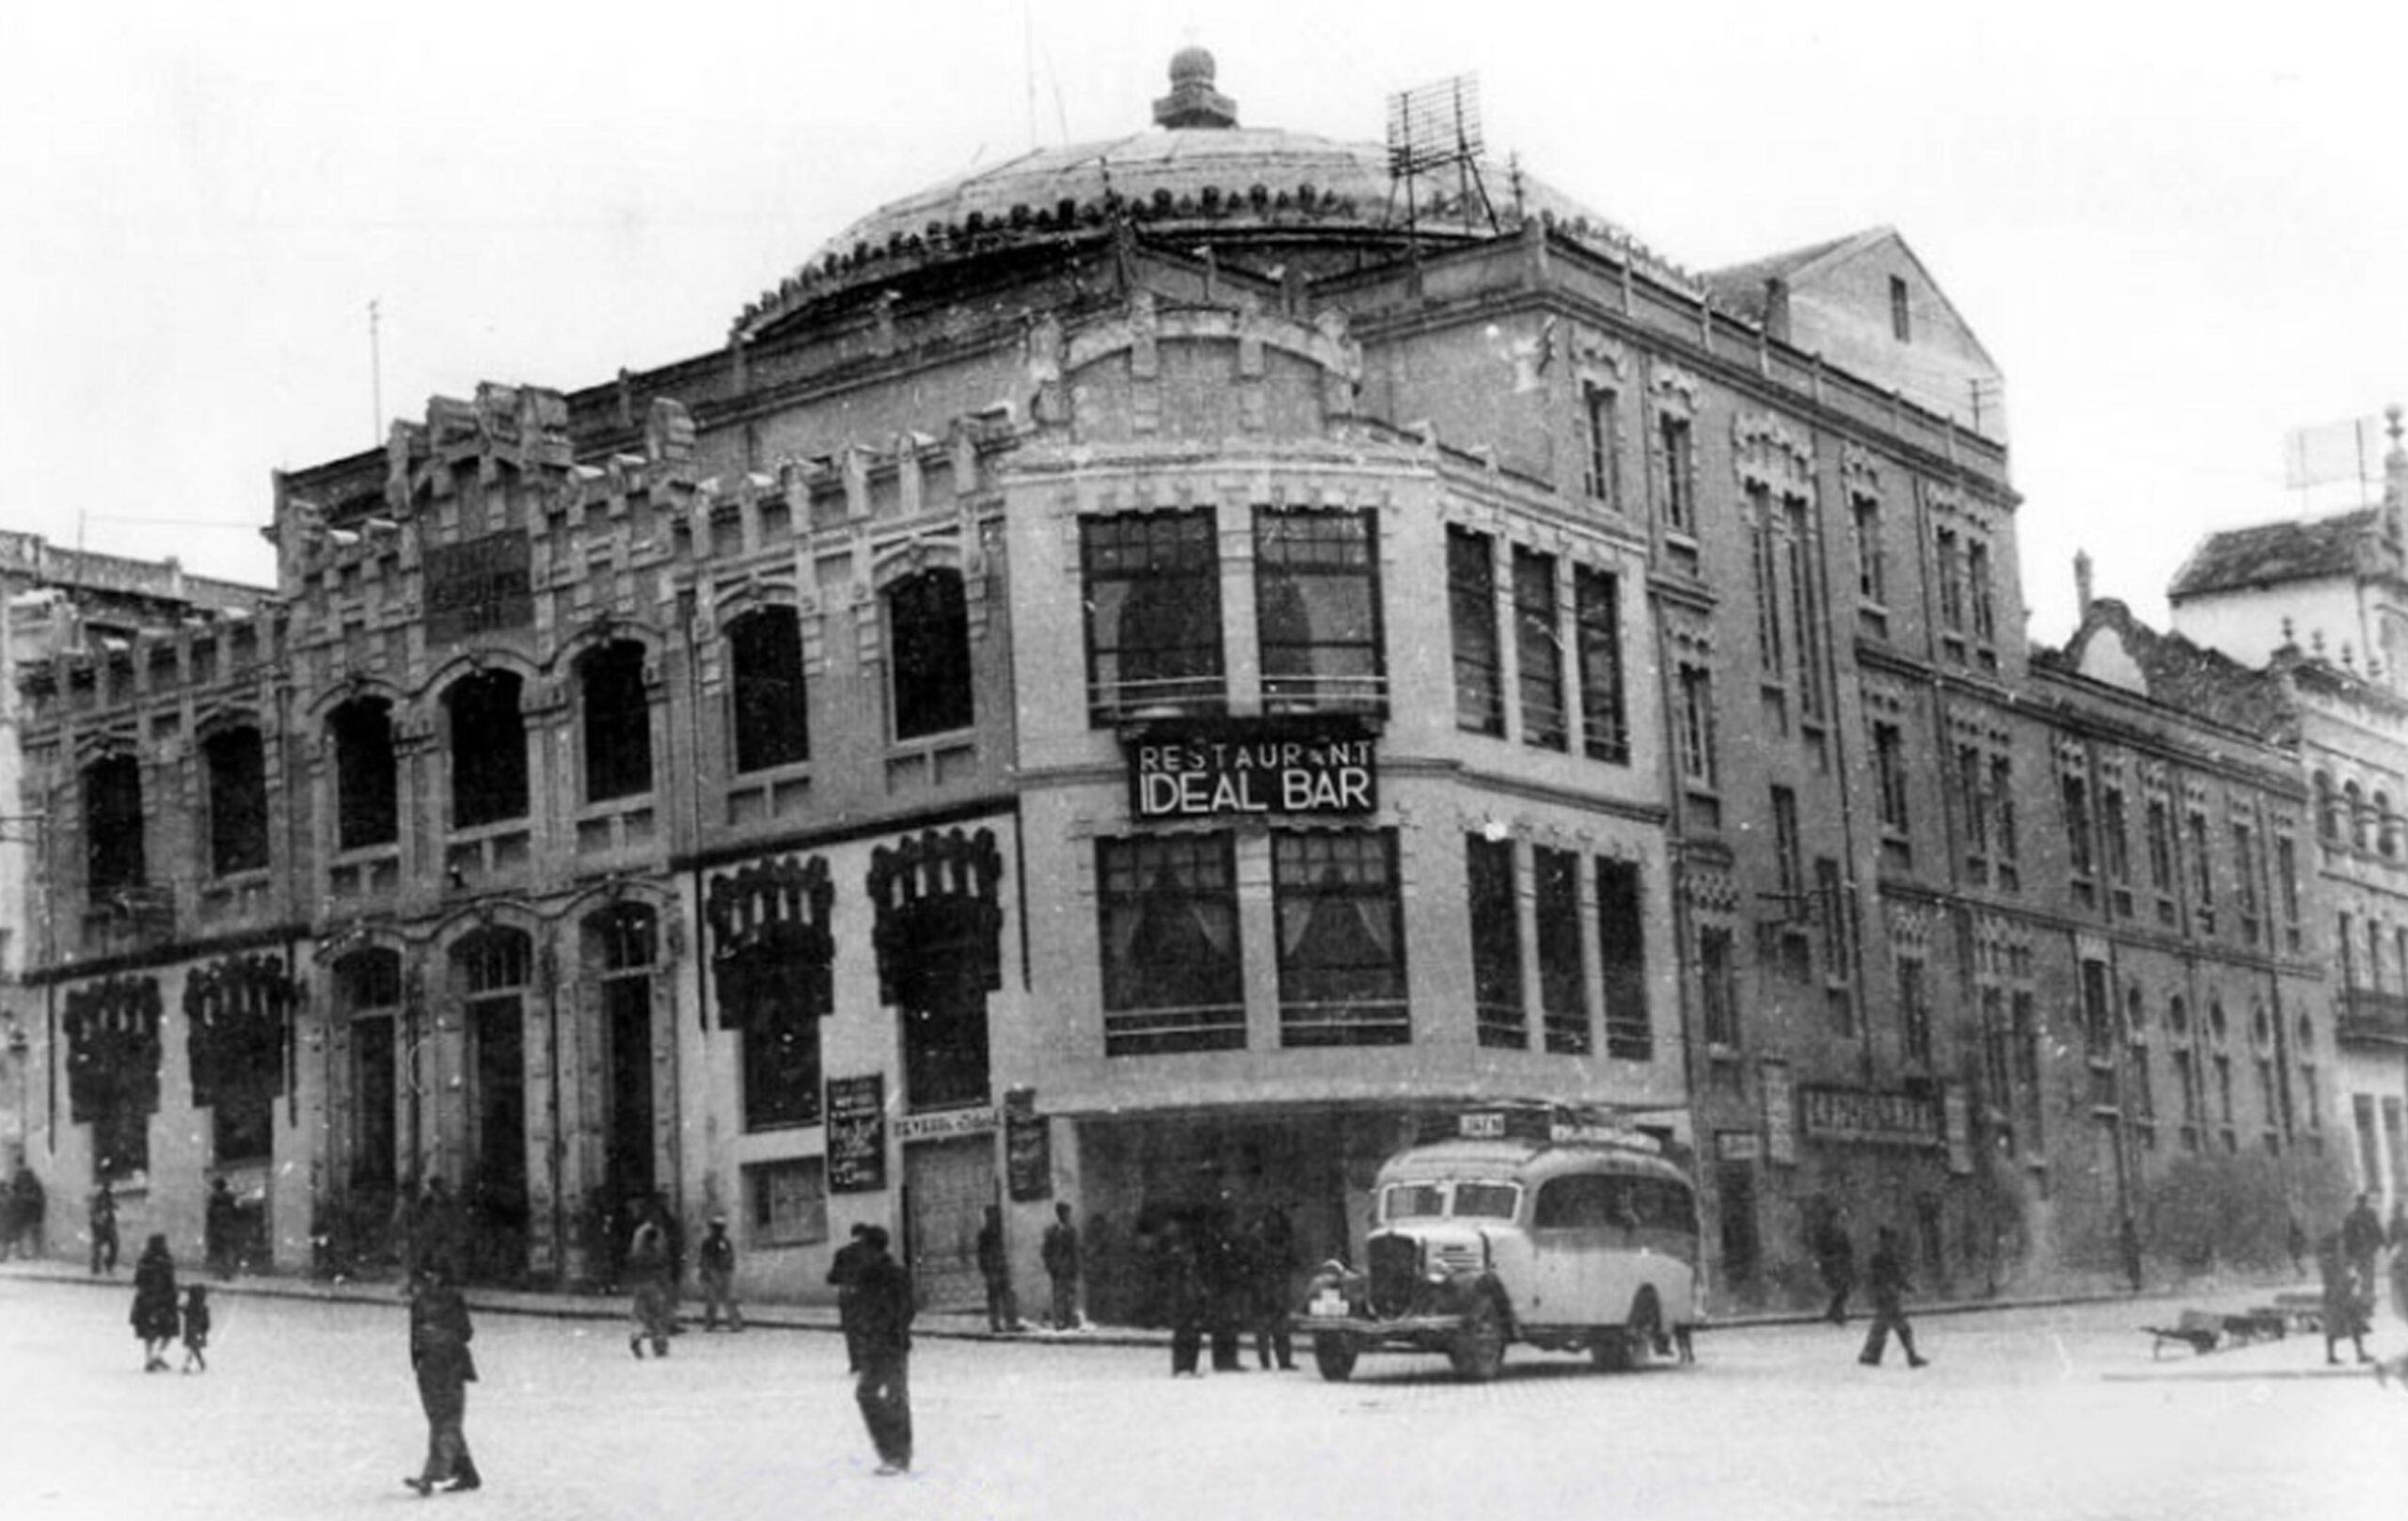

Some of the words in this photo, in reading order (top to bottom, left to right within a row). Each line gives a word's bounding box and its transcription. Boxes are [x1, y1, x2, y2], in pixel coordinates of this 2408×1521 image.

[1139, 741, 1370, 771] RESTAURANT
[1140, 770, 1268, 814] IDEAL
[1282, 767, 1370, 810] BAR
